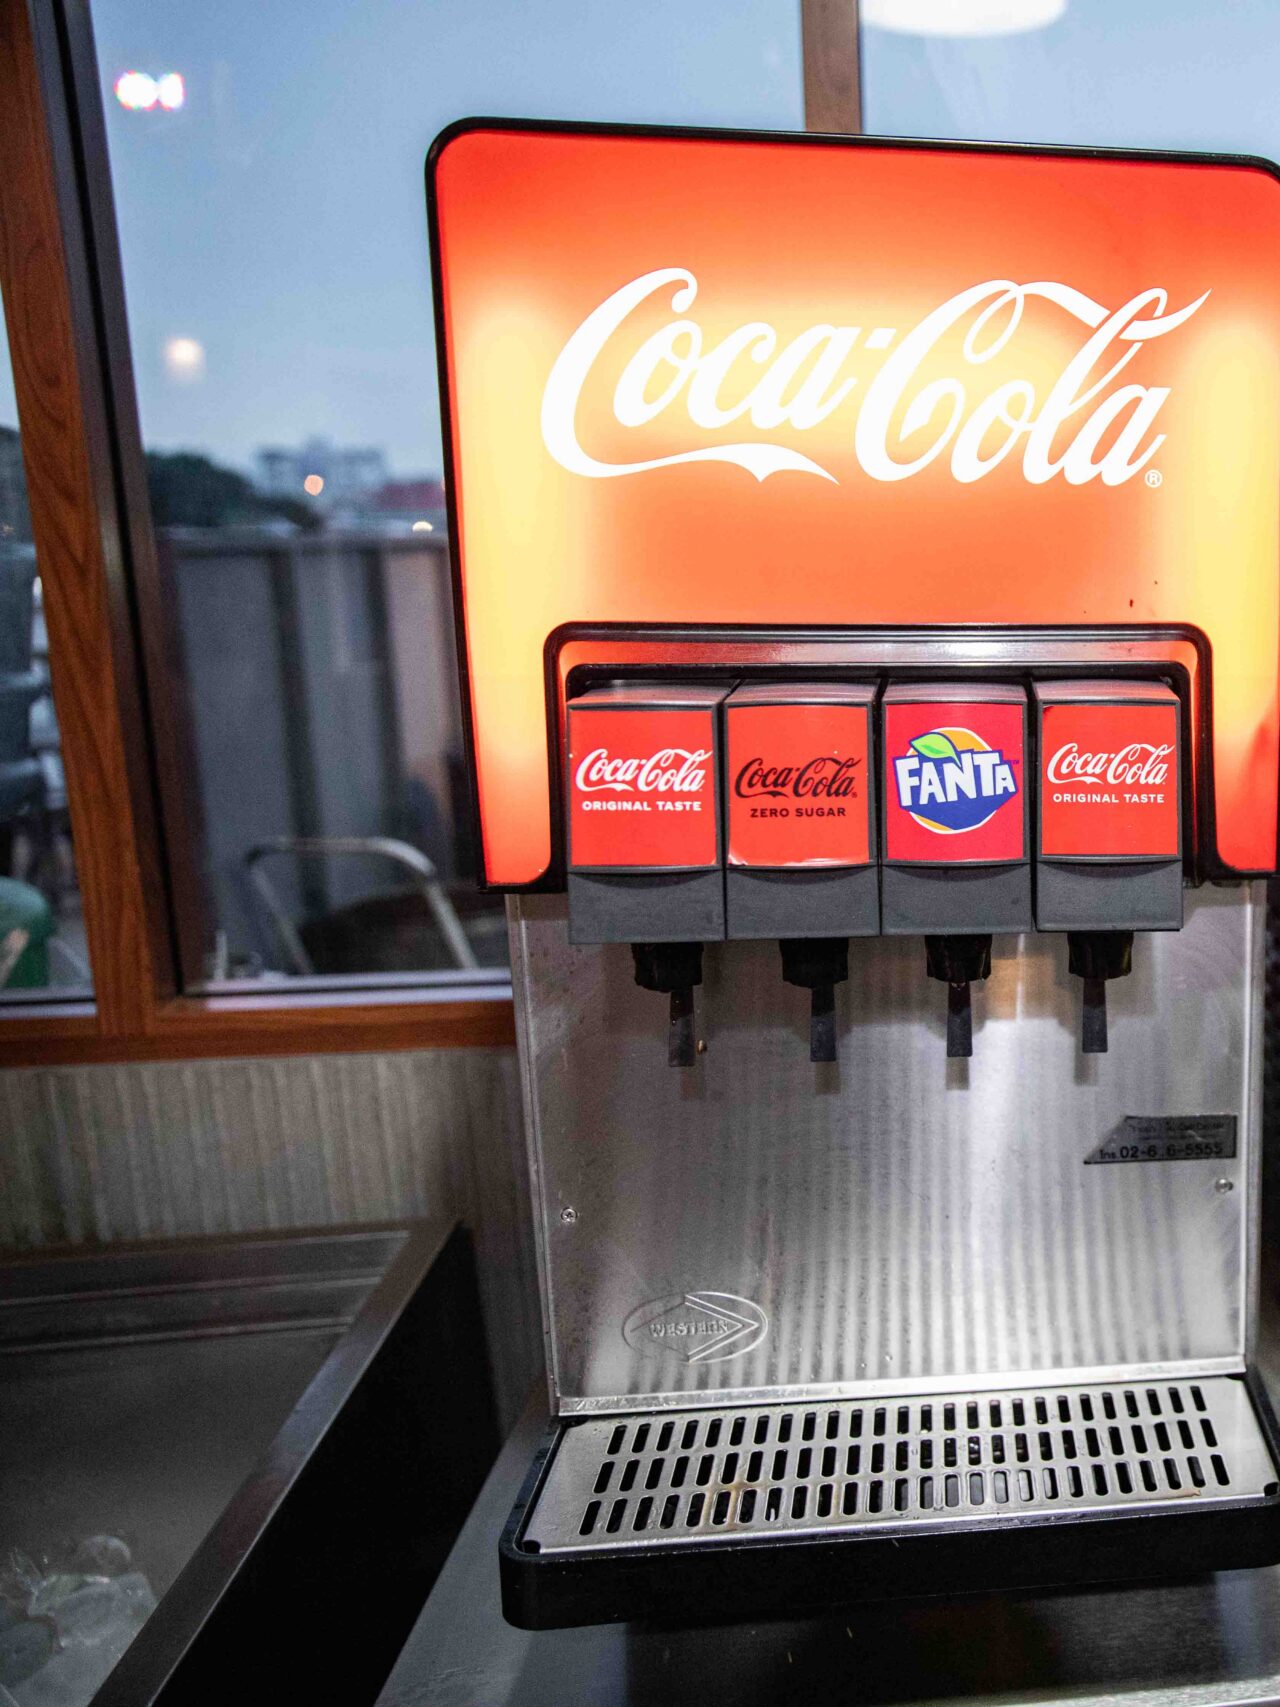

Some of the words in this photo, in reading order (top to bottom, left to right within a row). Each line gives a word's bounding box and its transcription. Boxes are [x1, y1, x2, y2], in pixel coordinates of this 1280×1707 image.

[575, 748, 713, 792] Coca-Cola
[1047, 743, 1175, 785] Coca-Cola
[895, 751, 1016, 807] FANTA
[582, 800, 651, 811] ORIGINAL
[656, 800, 702, 811] TASTE
[1053, 793, 1119, 803] ORIGINAL
[1124, 793, 1164, 803] TASTE
[750, 808, 789, 818] ZERO
[795, 807, 846, 817] SUGAR
[651, 1320, 729, 1337] WESTERN
